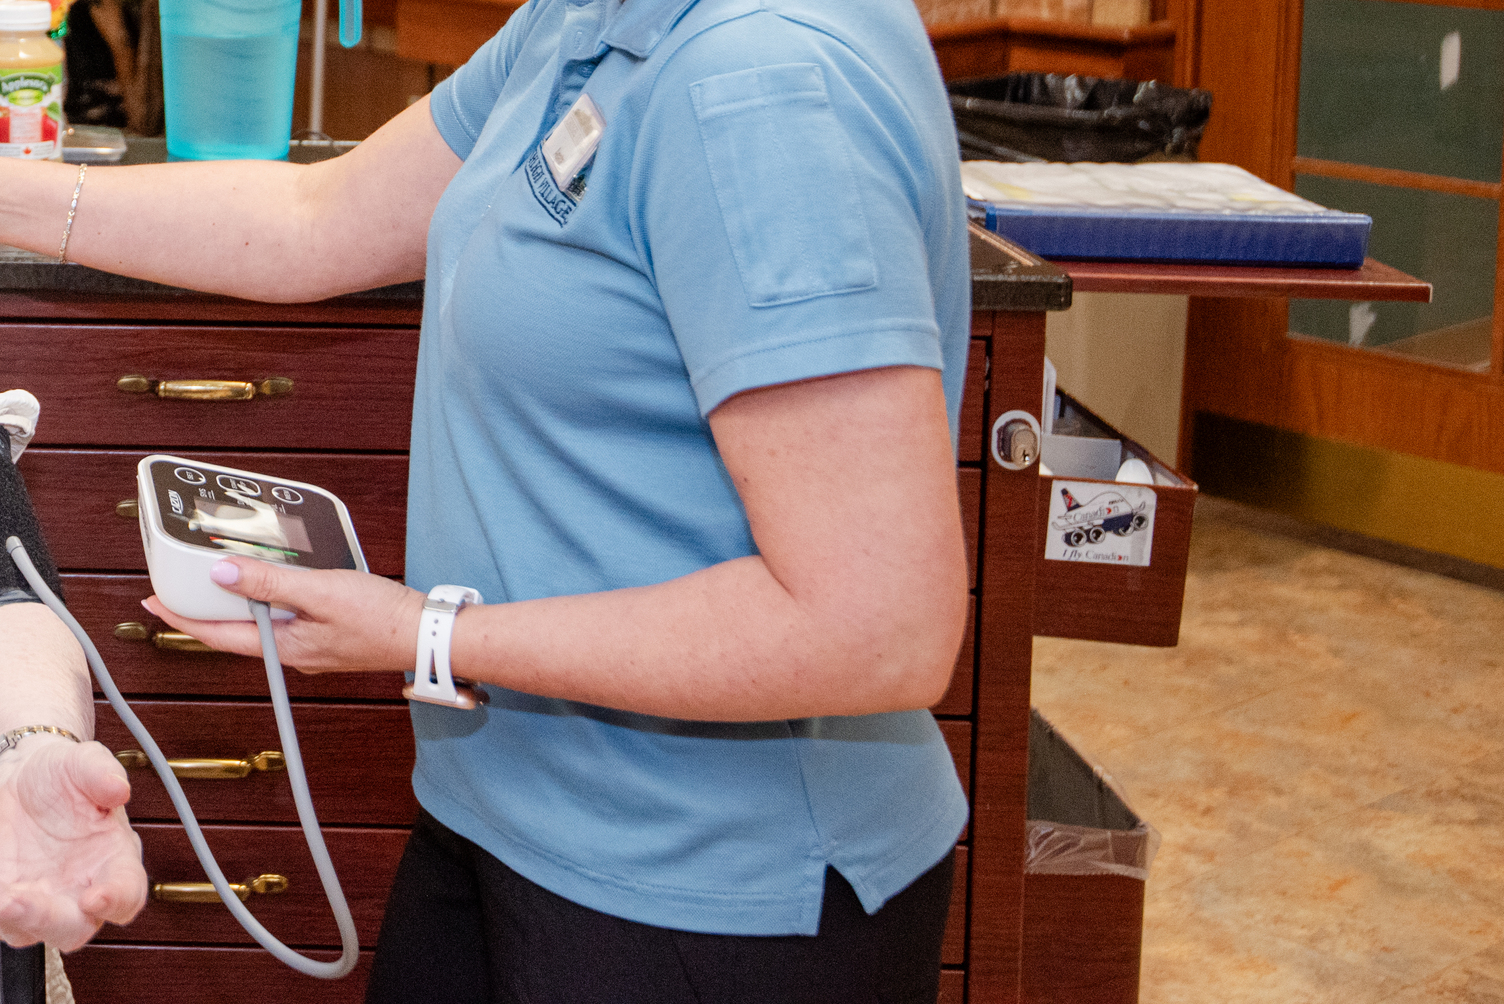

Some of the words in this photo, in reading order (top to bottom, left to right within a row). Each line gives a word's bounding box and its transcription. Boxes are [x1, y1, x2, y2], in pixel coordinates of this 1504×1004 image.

[199, 487, 207, 498] SYS
[168, 489, 183, 515] CAZON
[1068, 549, 1082, 561] fly
